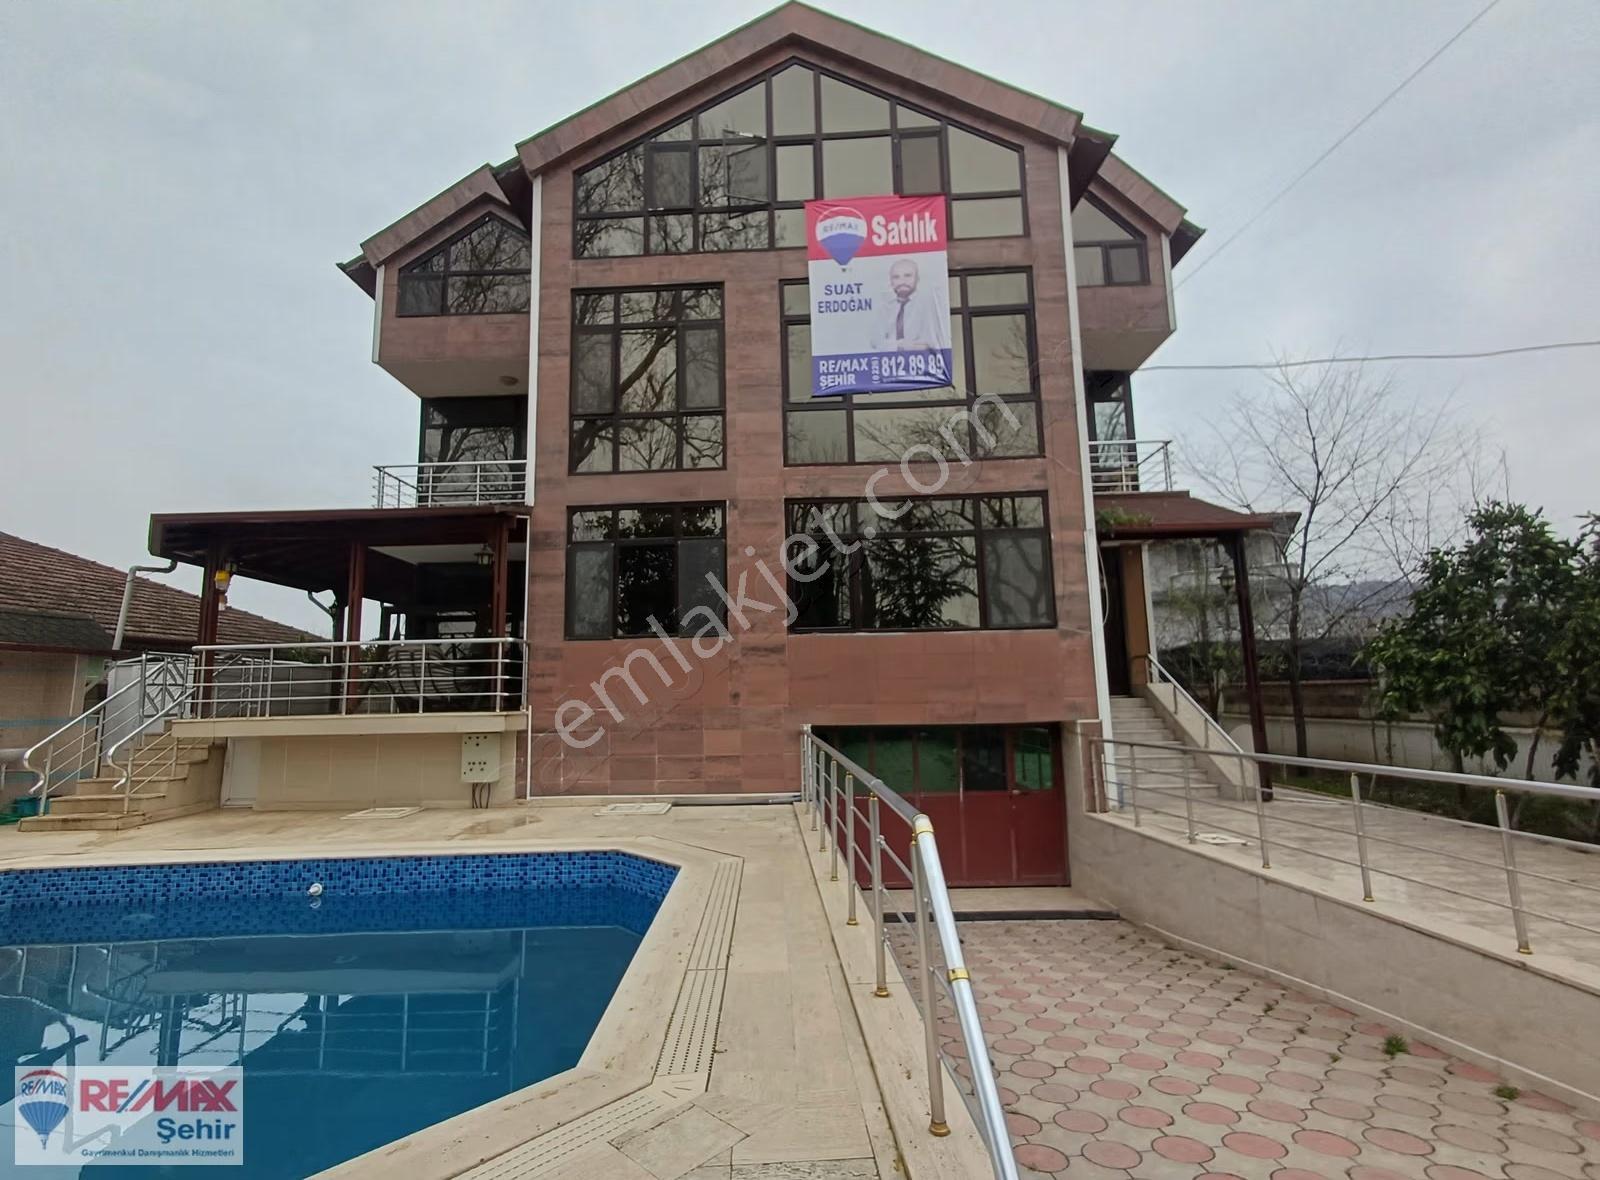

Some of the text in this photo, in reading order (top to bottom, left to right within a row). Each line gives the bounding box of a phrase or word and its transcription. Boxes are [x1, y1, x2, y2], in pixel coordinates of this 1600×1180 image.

[871, 211, 938, 247] Satılık
[824, 282, 863, 296] SUAT
[817, 298, 872, 314] ERDOĞAN
[819, 358, 869, 374] RE/MAX
[881, 356, 906, 377] 812
[819, 373, 856, 390] ŞEHİR
